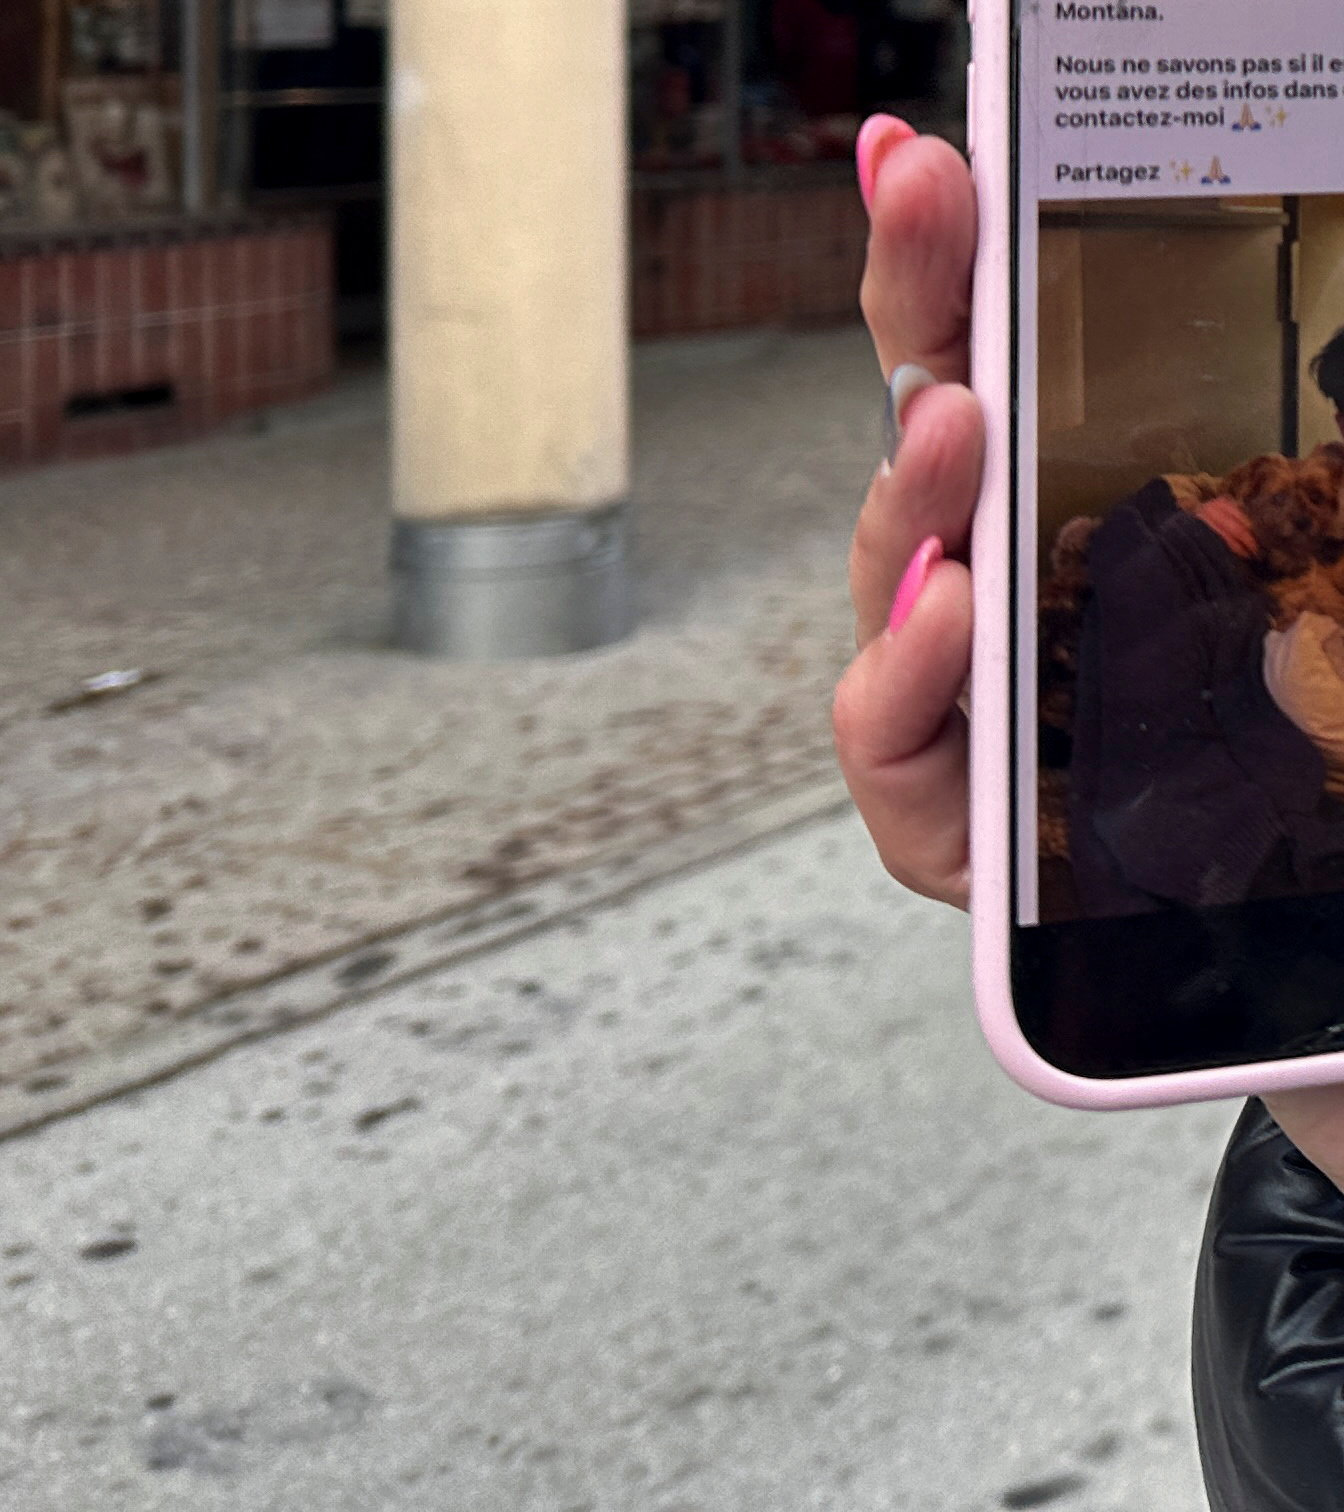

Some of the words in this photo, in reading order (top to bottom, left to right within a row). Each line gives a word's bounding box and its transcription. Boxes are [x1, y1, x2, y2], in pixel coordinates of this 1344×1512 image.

[1055, 55, 1116, 74] Nous
[1122, 58, 1150, 74] ne
[1157, 58, 1236, 74] savons
[1242, 57, 1282, 76] pas
[1288, 53, 1306, 73] si
[1312, 53, 1324, 73] il
[1055, 84, 1110, 101] vous
[1116, 84, 1169, 101] avez
[1175, 81, 1217, 99] des
[1222, 79, 1279, 99] infos
[1284, 80, 1338, 99] dans
[1055, 107, 1225, 128] contactez-moi
[1055, 163, 1161, 184] Partagez
